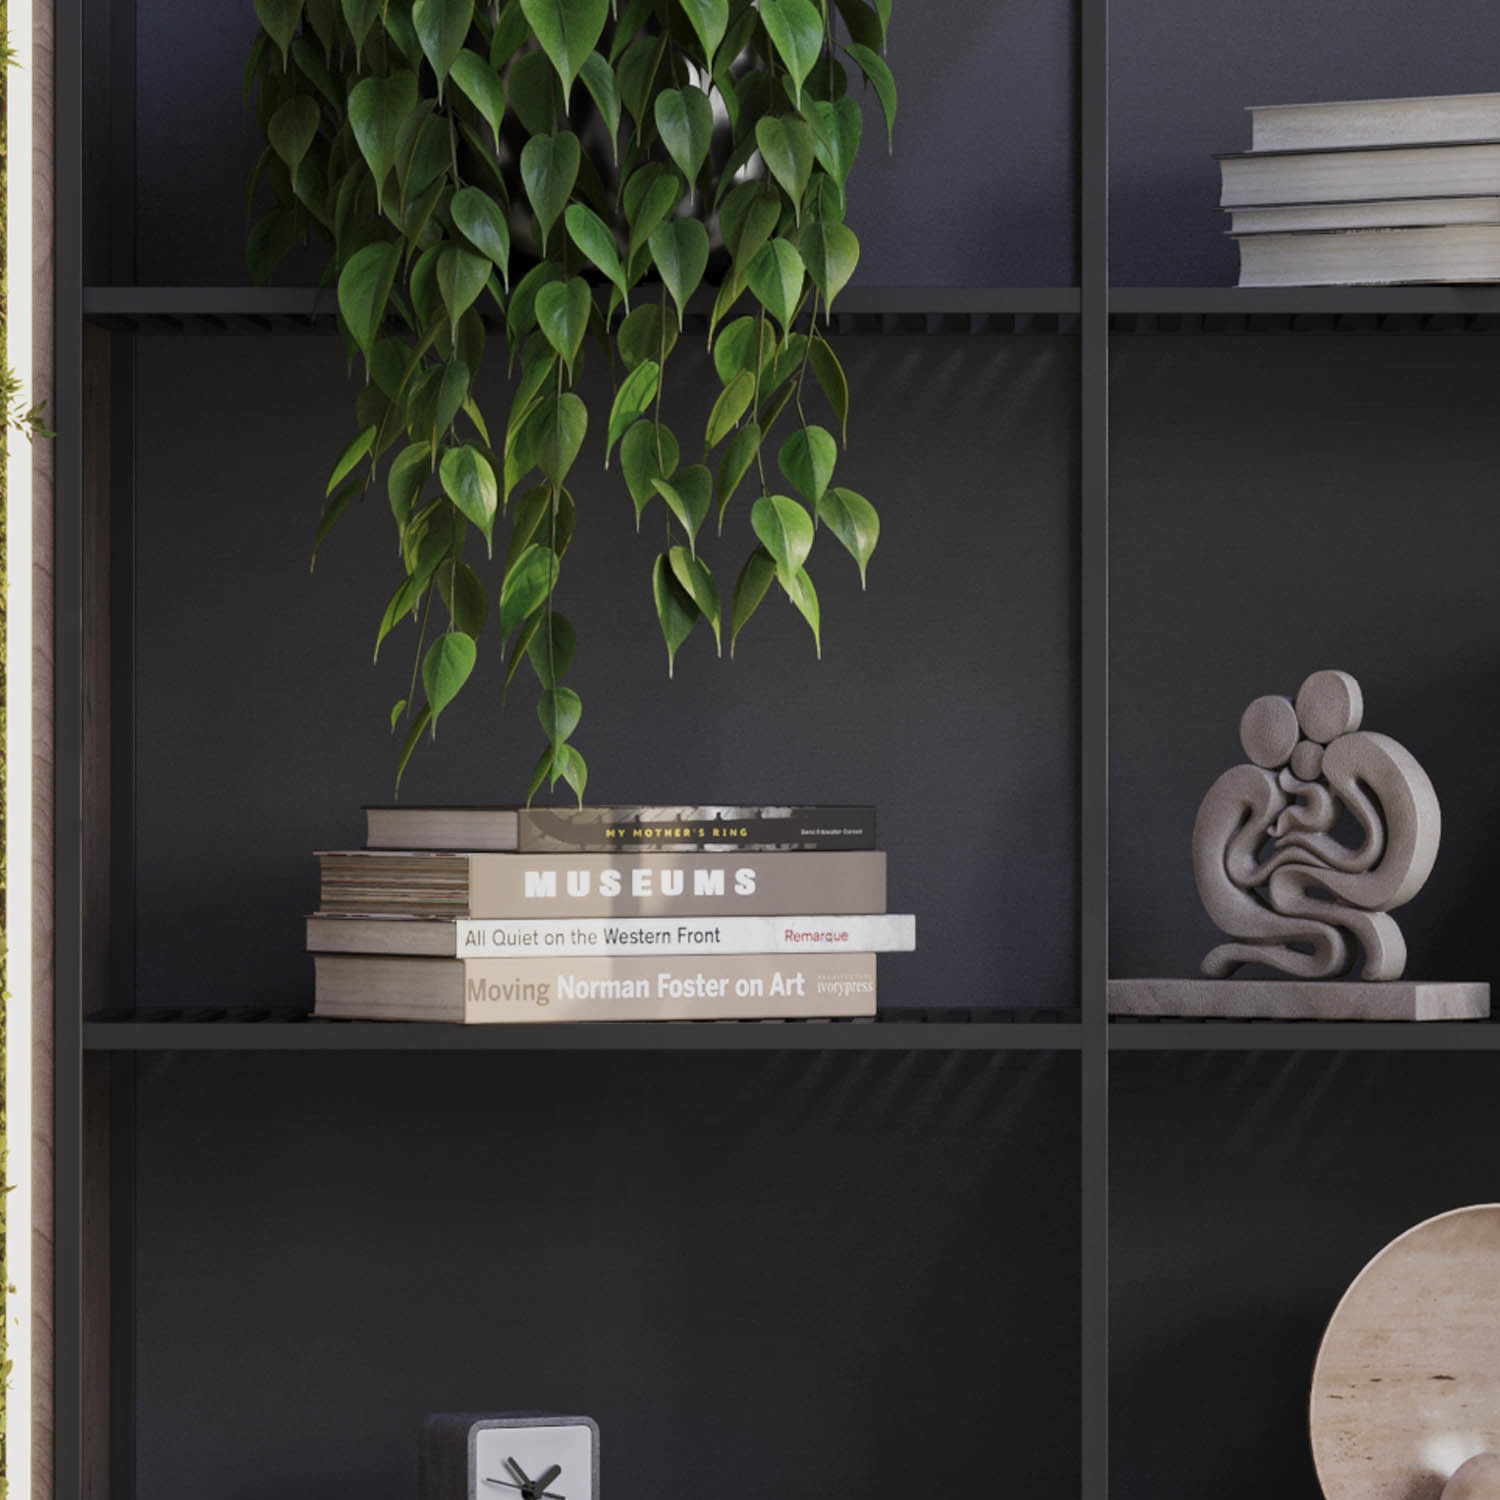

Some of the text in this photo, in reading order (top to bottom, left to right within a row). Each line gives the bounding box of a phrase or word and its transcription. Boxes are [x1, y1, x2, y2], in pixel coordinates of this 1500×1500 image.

[605, 828, 749, 838] MY MOTHER'S RING
[525, 867, 758, 898] MUSEUMS
[465, 926, 848, 946] All Quiet on the Western Front Remarque
[467, 971, 805, 1006] Moving Norman Foster on Art
